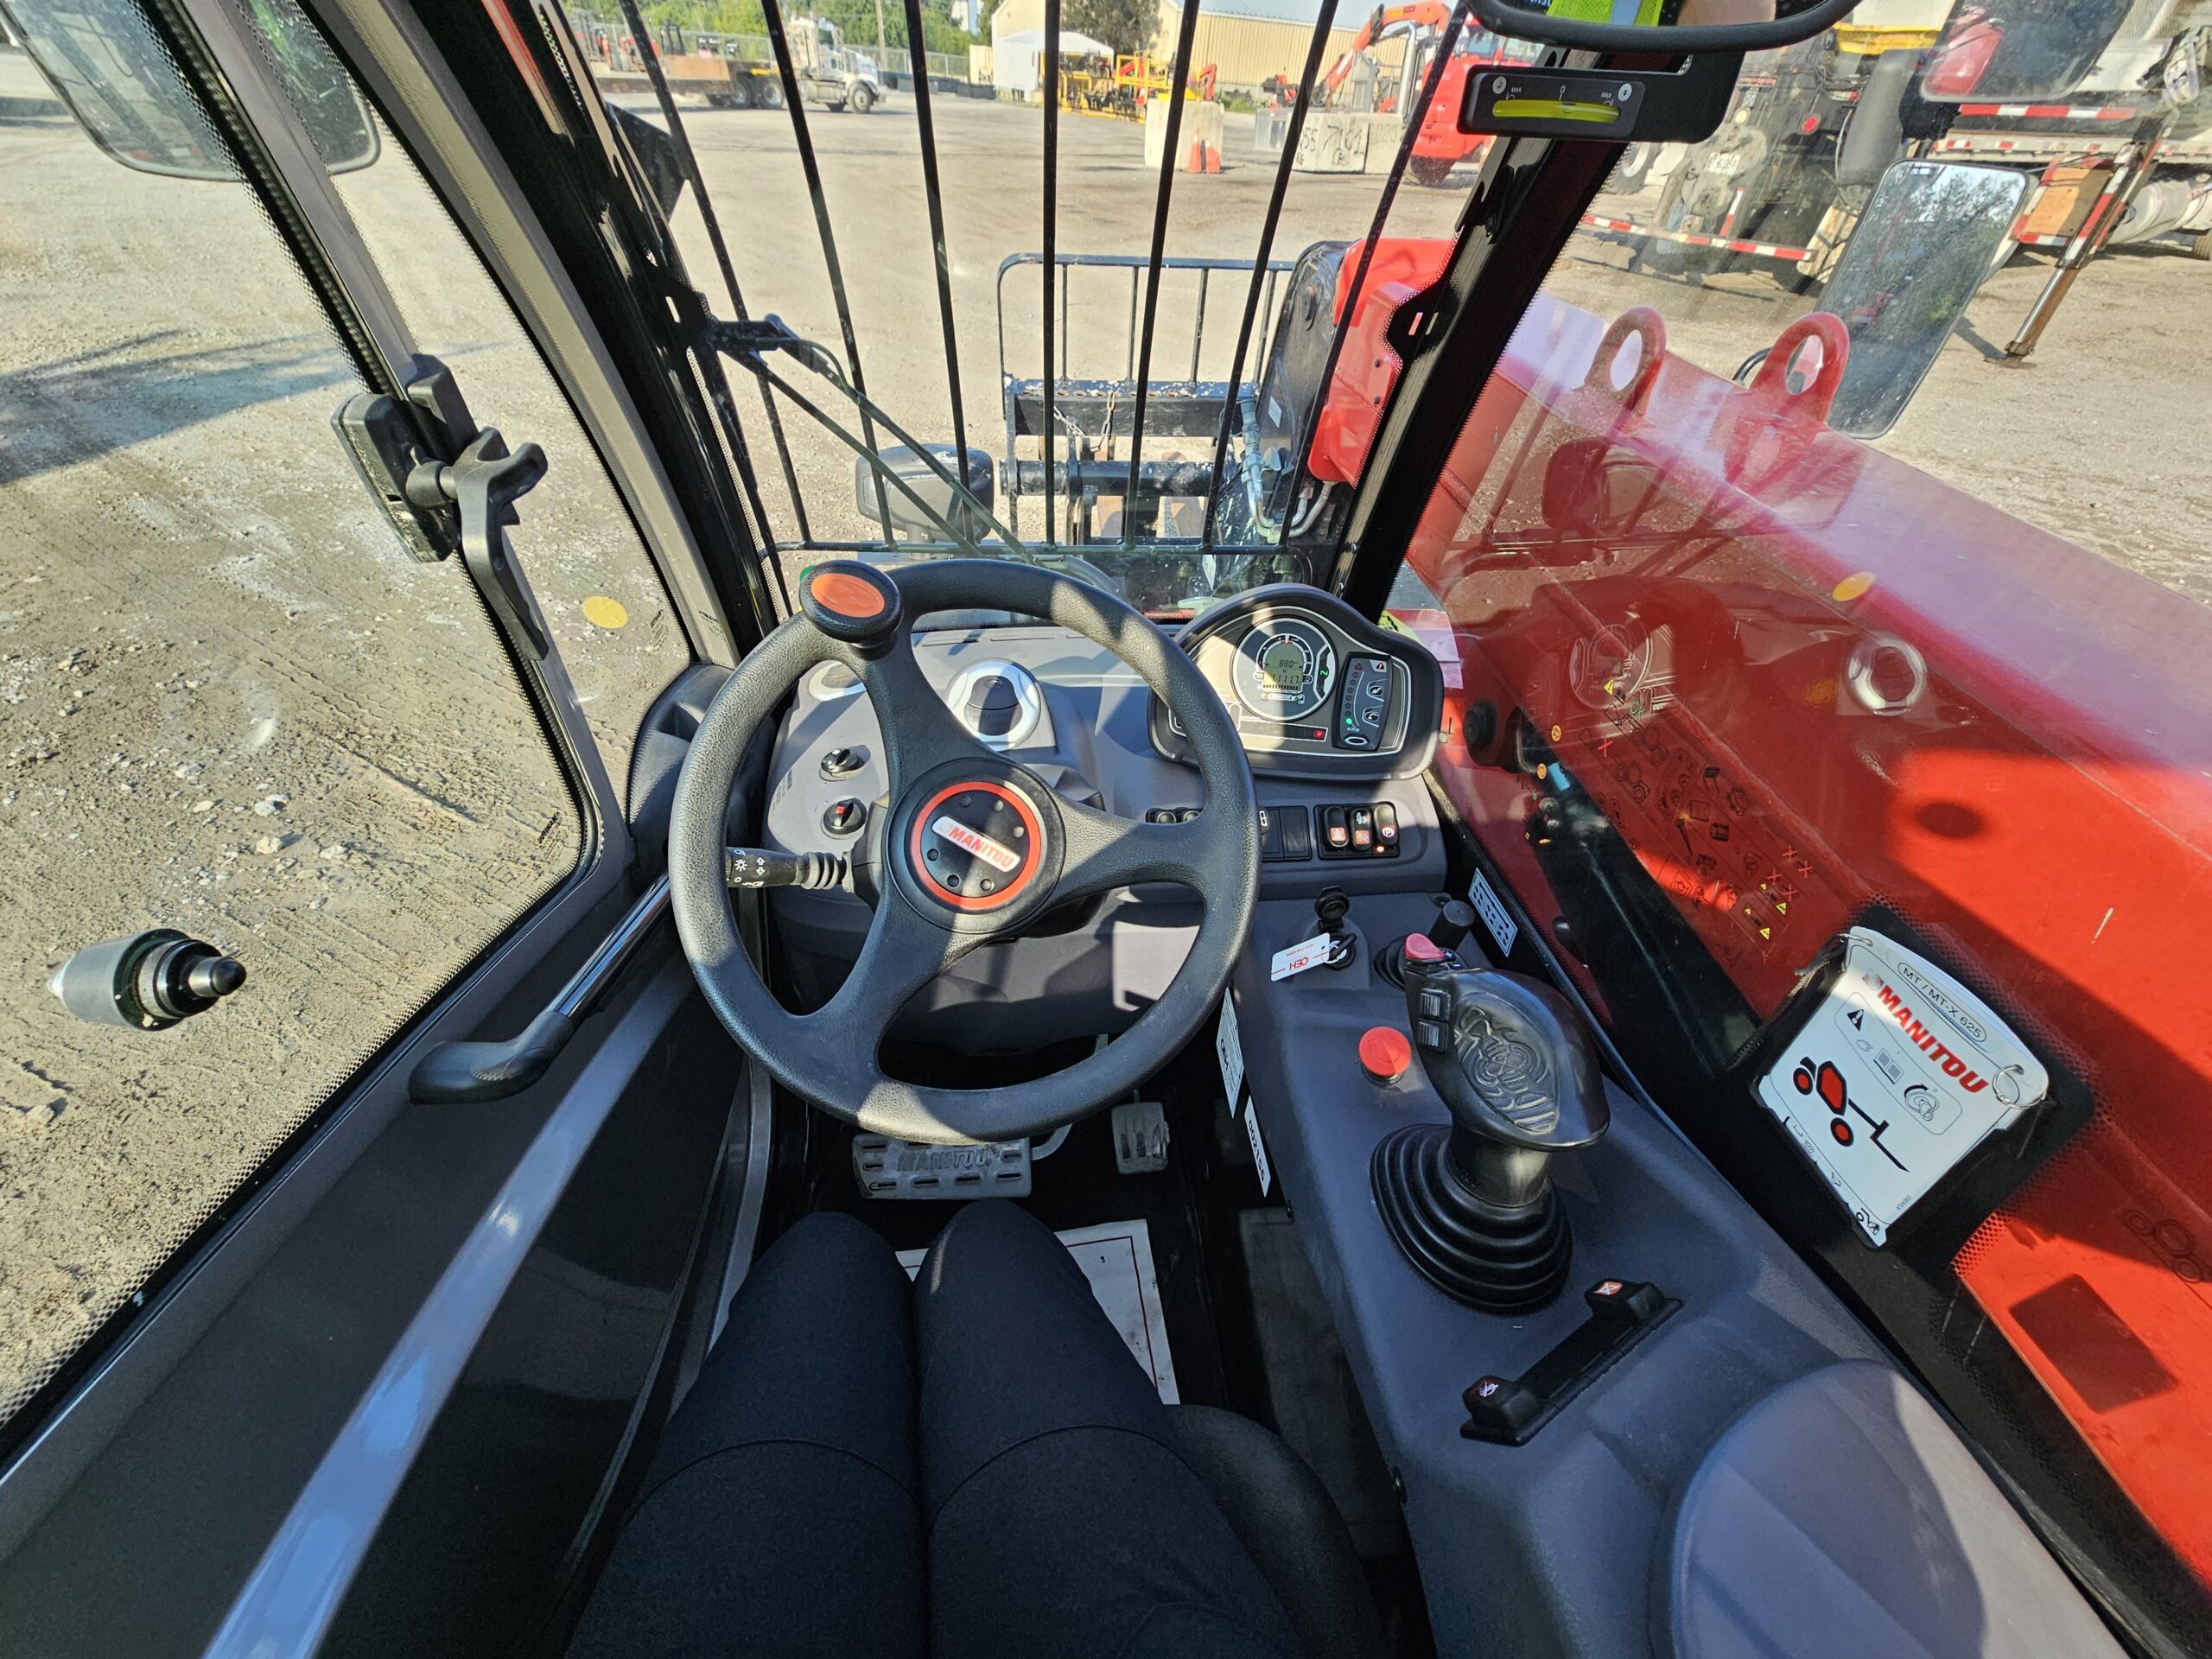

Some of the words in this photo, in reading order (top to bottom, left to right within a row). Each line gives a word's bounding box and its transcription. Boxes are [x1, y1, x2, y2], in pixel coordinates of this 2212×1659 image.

[1279, 659, 1294, 668] 880
[948, 826, 1014, 868] MANITOU
[1903, 968, 1923, 984] MT
[1929, 988, 1959, 1018] MT-X
[1960, 1016, 1982, 1038] 625
[1878, 984, 1989, 1093] MANITOU
[1249, 1119, 1265, 1182] 002156
